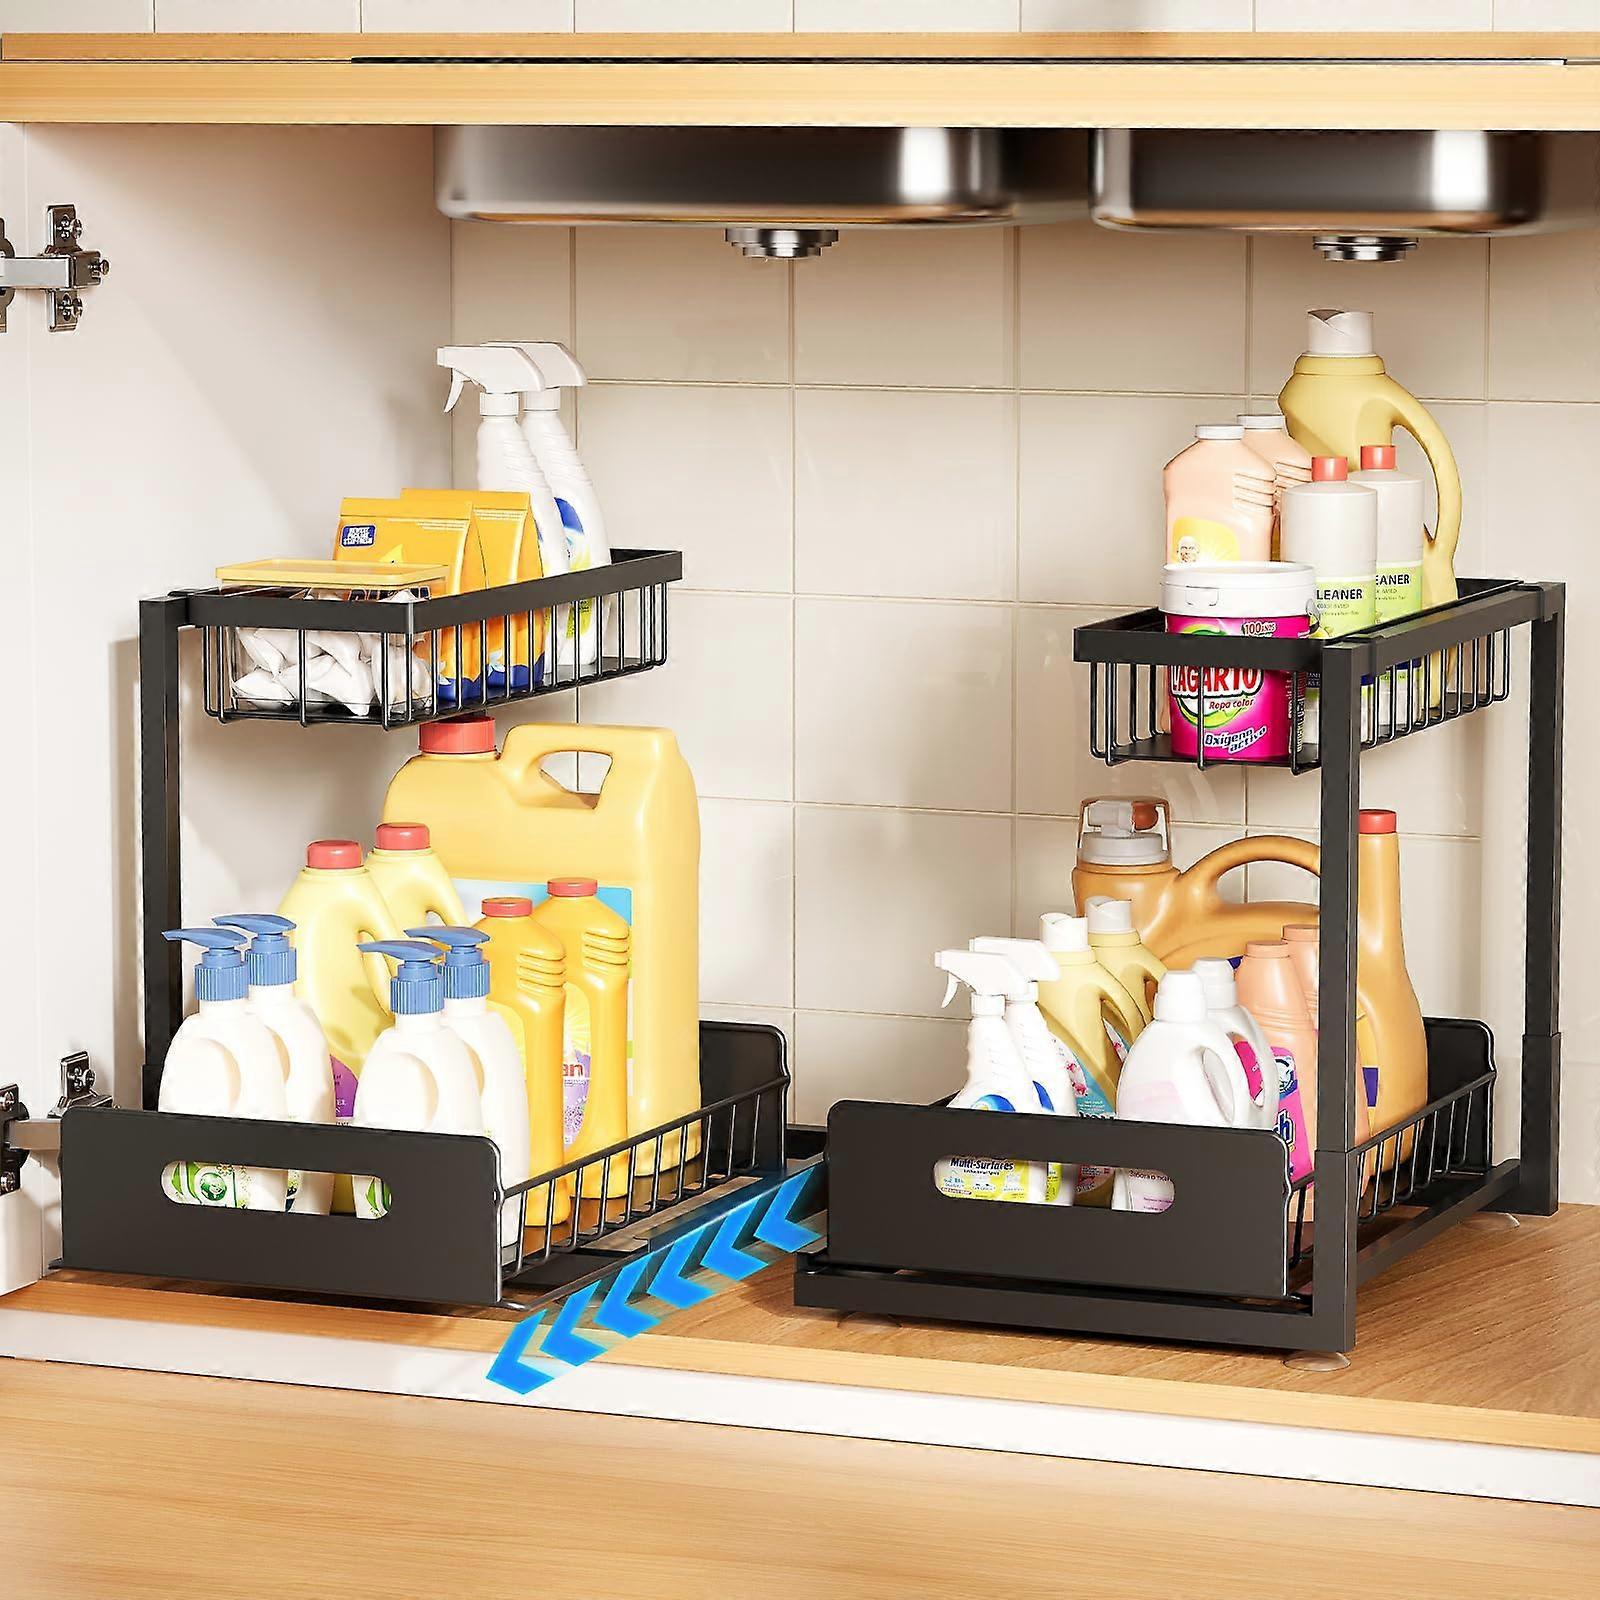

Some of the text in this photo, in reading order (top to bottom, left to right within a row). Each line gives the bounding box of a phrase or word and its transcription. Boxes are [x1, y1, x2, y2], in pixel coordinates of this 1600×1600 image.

[1209, 698, 1254, 710] Ropa color
[950, 1158, 1014, 1171] Multi-Surfaces
